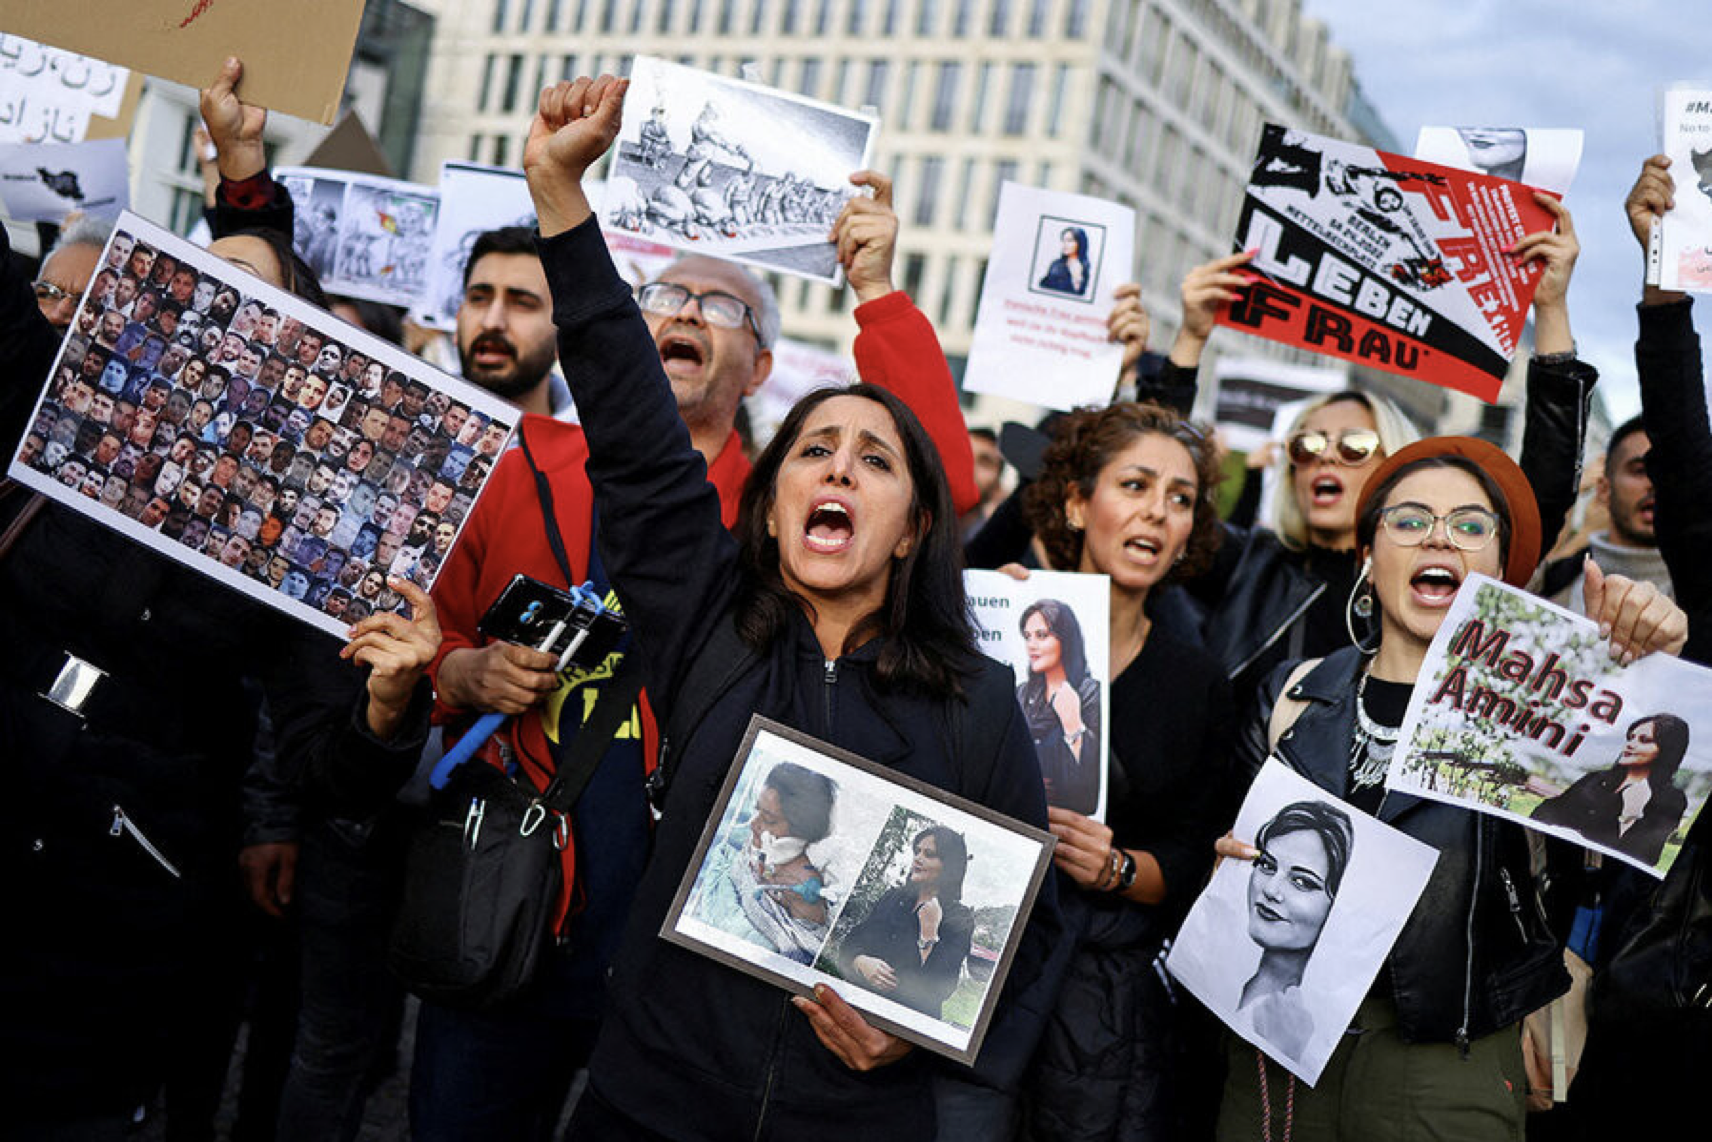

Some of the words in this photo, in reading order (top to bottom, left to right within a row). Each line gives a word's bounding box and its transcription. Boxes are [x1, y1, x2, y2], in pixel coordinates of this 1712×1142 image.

[1248, 206, 1433, 338] LEBEN
[1348, 213, 1392, 250] BERLIN
[1431, 665, 1590, 758] Amini
[1452, 618, 1624, 725] Mahsa
